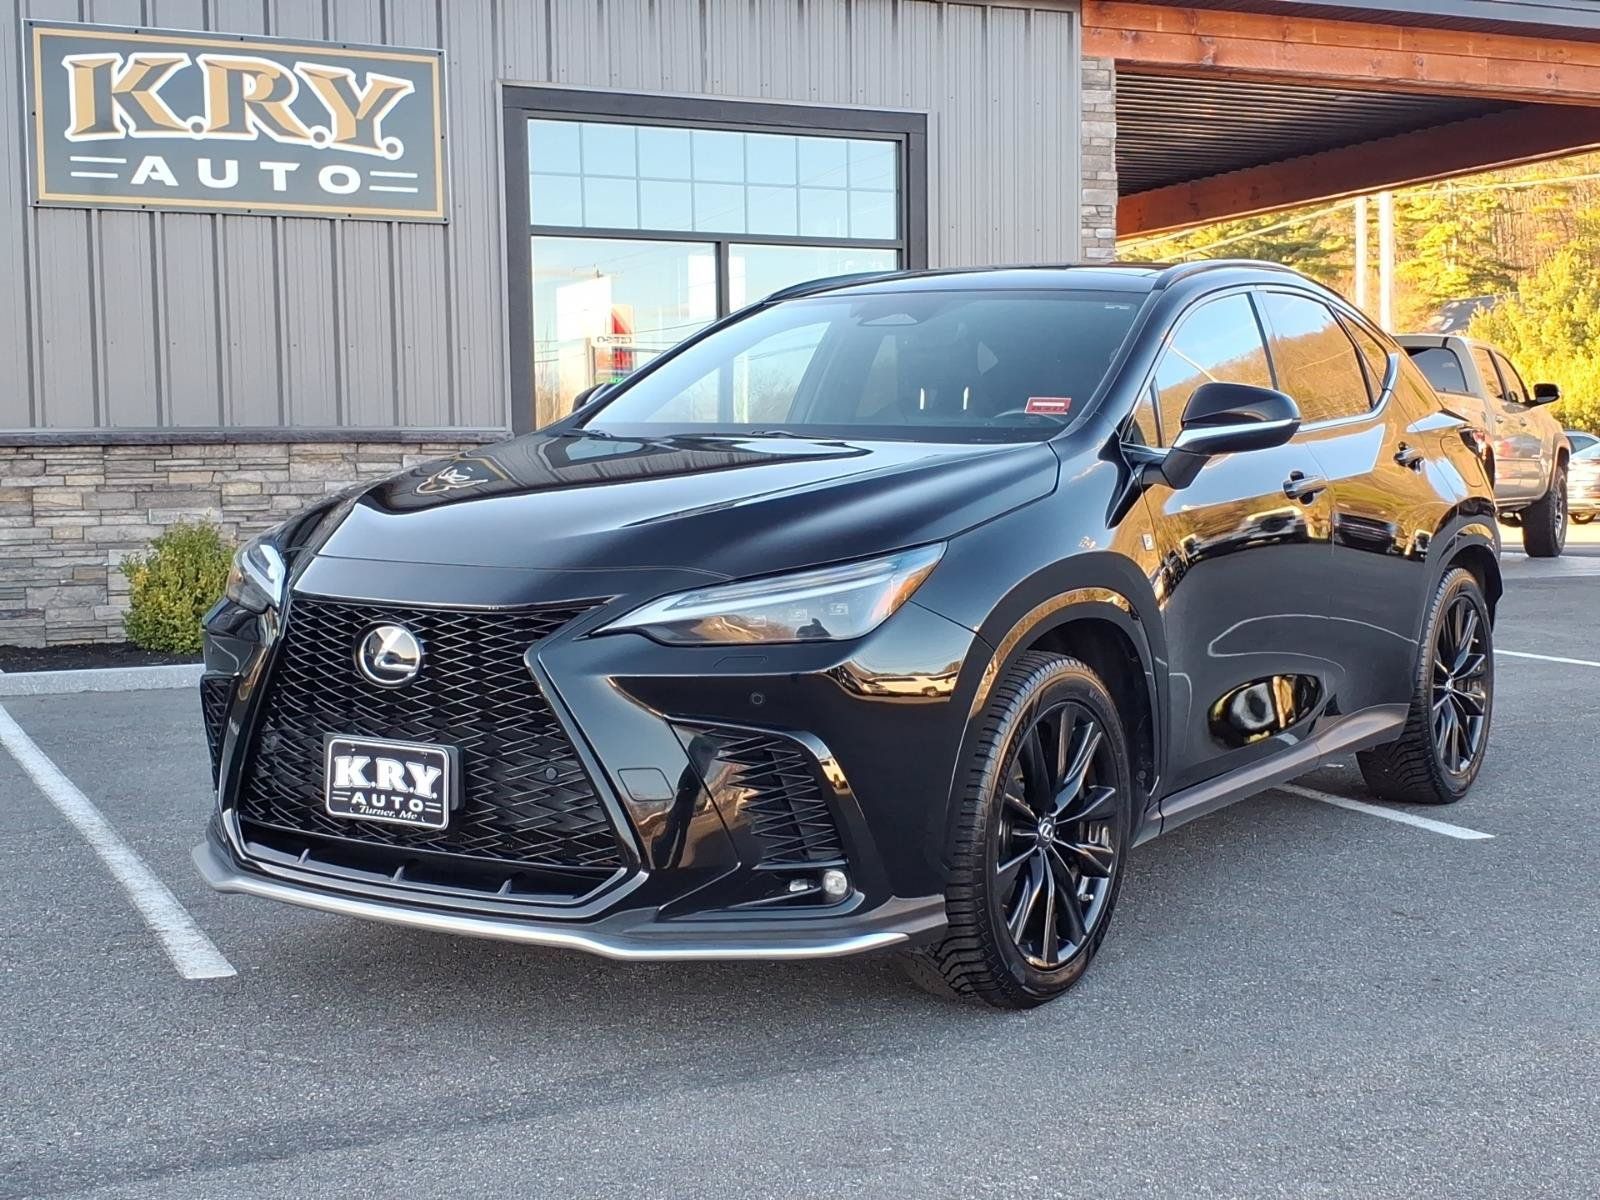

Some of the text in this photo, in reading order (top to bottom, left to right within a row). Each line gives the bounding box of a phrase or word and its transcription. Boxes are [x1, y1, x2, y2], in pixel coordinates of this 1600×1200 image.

[62, 52, 416, 160] K.R.Y.
[130, 155, 361, 195] AUTO
[333, 755, 442, 799] K.R.Y.
[351, 791, 424, 812] AUTO
